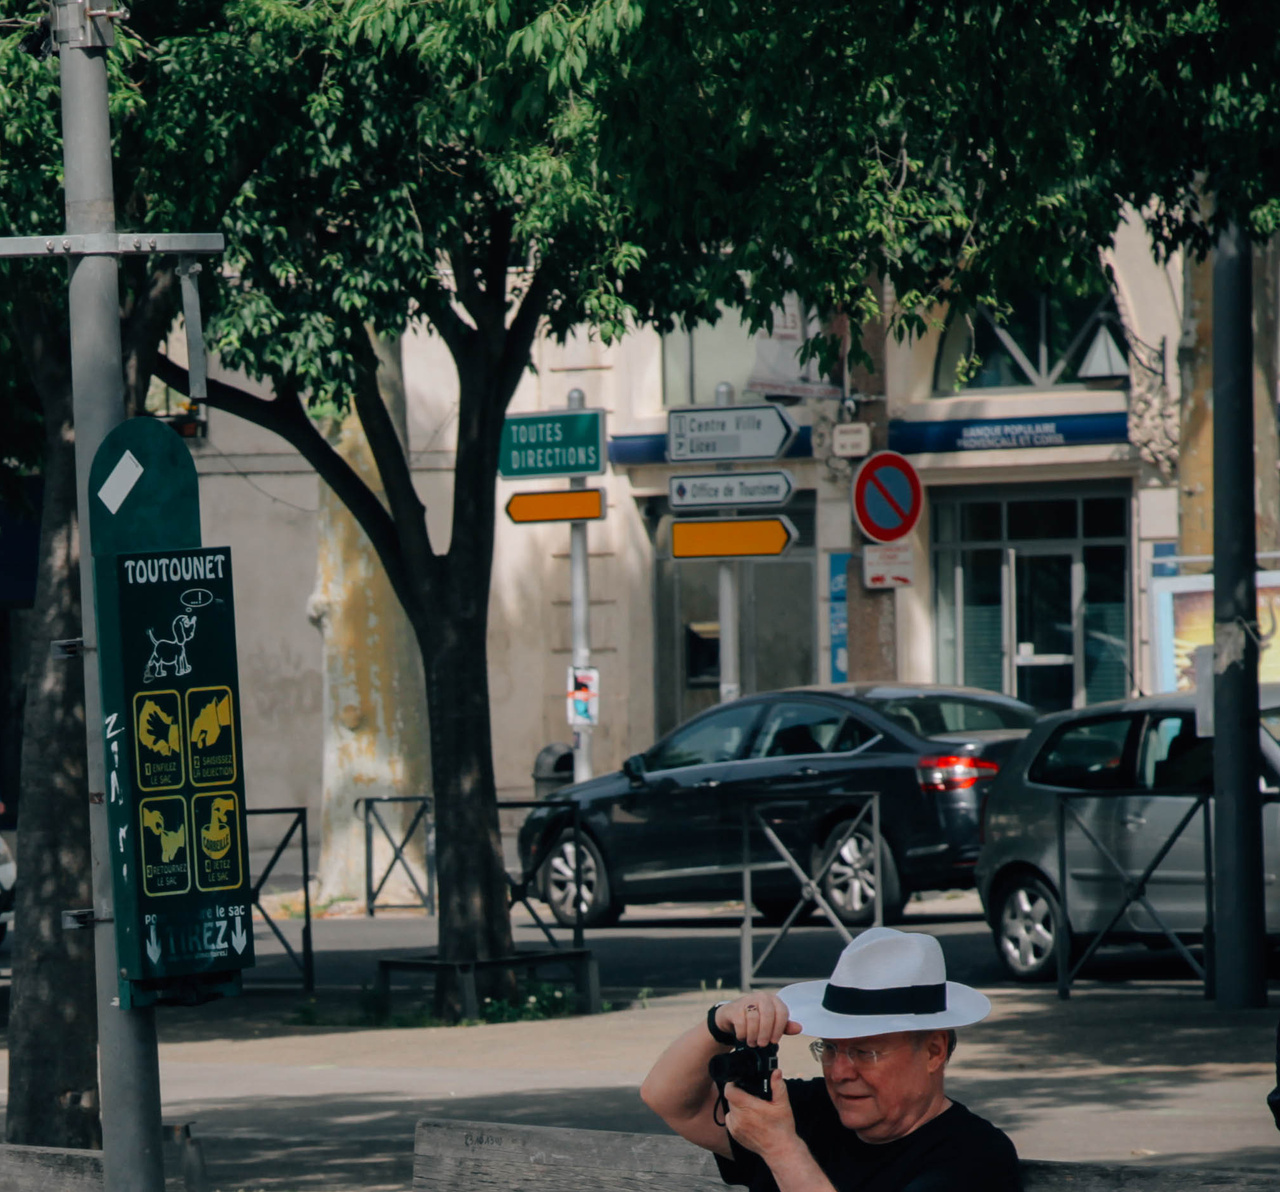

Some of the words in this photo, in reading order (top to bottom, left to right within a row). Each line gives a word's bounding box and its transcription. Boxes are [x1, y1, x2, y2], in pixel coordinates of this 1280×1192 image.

[689, 418, 726, 432] Centre
[511, 423, 563, 443] TOUTES
[511, 446, 597, 469] DIRECTIONS
[691, 483, 719, 499] Office
[723, 483, 735, 498] de
[739, 481, 780, 497] Tourisme
[125, 555, 225, 584] TOUTOUNET
[203, 754, 233, 765] SAISISSEZ
[153, 762, 177, 772] ENFILEZ
[151, 776, 158, 785] LE
[160, 775, 172, 784] SAC
[153, 863, 187, 875] RETOURNEZ
[157, 877, 164, 886] LE
[166, 876, 177, 885] SAC
[208, 873, 215, 882] LE
[217, 872, 229, 881] SAC
[216, 905, 225, 918] le
[228, 905, 245, 917] sac
